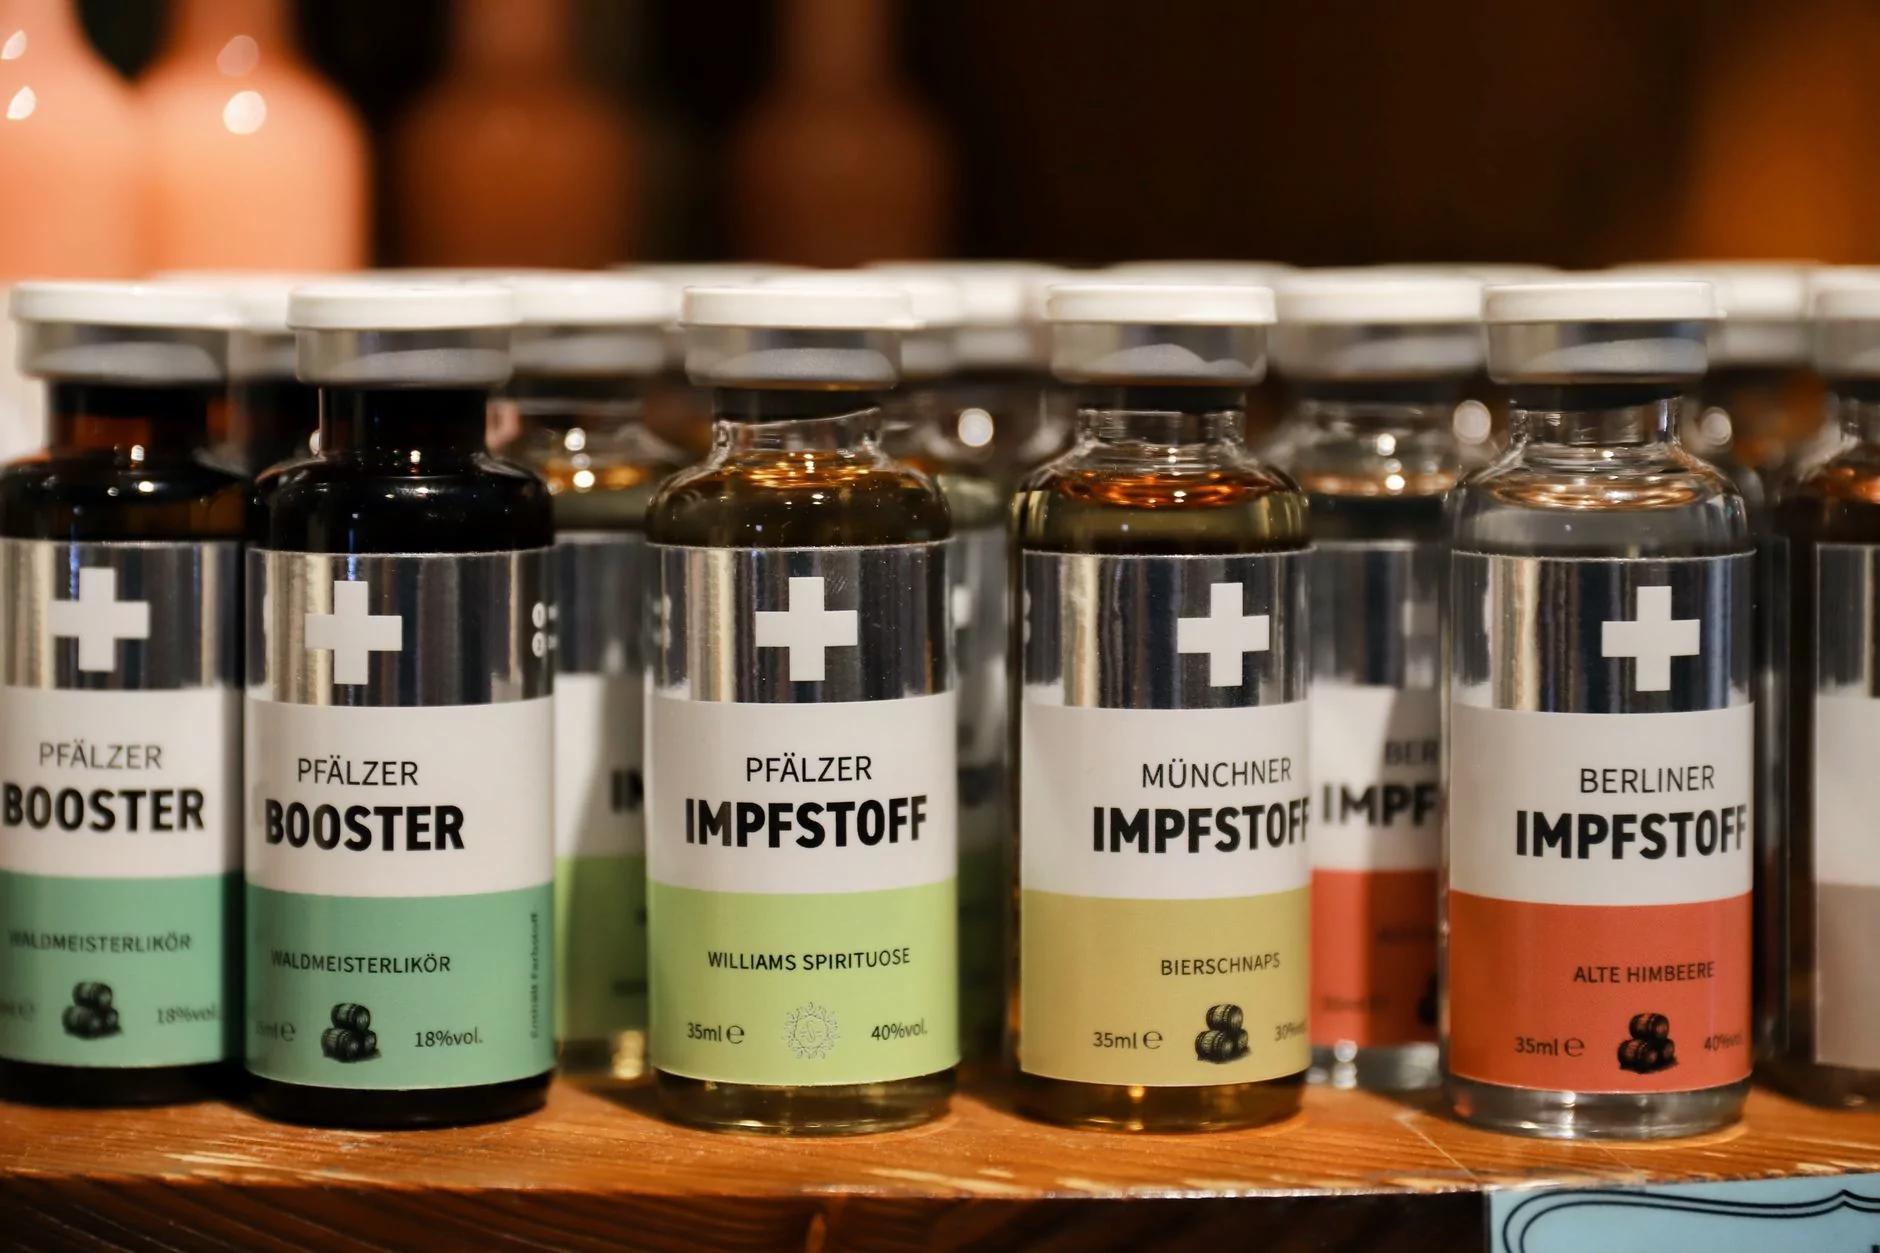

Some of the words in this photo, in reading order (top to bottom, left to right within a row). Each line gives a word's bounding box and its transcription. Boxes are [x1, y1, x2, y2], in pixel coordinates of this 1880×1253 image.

[38, 738, 163, 770] PFÄLZER
[745, 752, 873, 782] PFÄLZER
[297, 755, 418, 786] PFÄLZER
[1141, 757, 1292, 789] MÜNCHNER
[1580, 765, 1715, 794] BERLINER
[3, 782, 205, 832] BOOSTER
[265, 799, 465, 851] BOOSTER
[685, 794, 928, 849] IMPFSTOFF
[1093, 797, 1310, 854] IMPFSTOFF
[1515, 804, 1747, 860] IMPFSTOFF
[9, 930, 192, 952] WALDMEISTERLIKÖR
[271, 949, 451, 974] WALDMEISTERLIKÖR
[707, 951, 797, 971] WILLIAMS
[803, 948, 911, 971] SPIRITUOSE
[1160, 952, 1281, 976] BIERSCHNAPS
[1573, 966, 1620, 984] ALTE
[1626, 961, 1715, 983] HIMBEERE
[414, 1027, 483, 1048] 18%vol.
[686, 1022, 722, 1043] 35ml
[870, 1019, 928, 1042] 40%vol.
[1093, 1031, 1138, 1050] 35ml
[1514, 1036, 1559, 1056] 35ml
